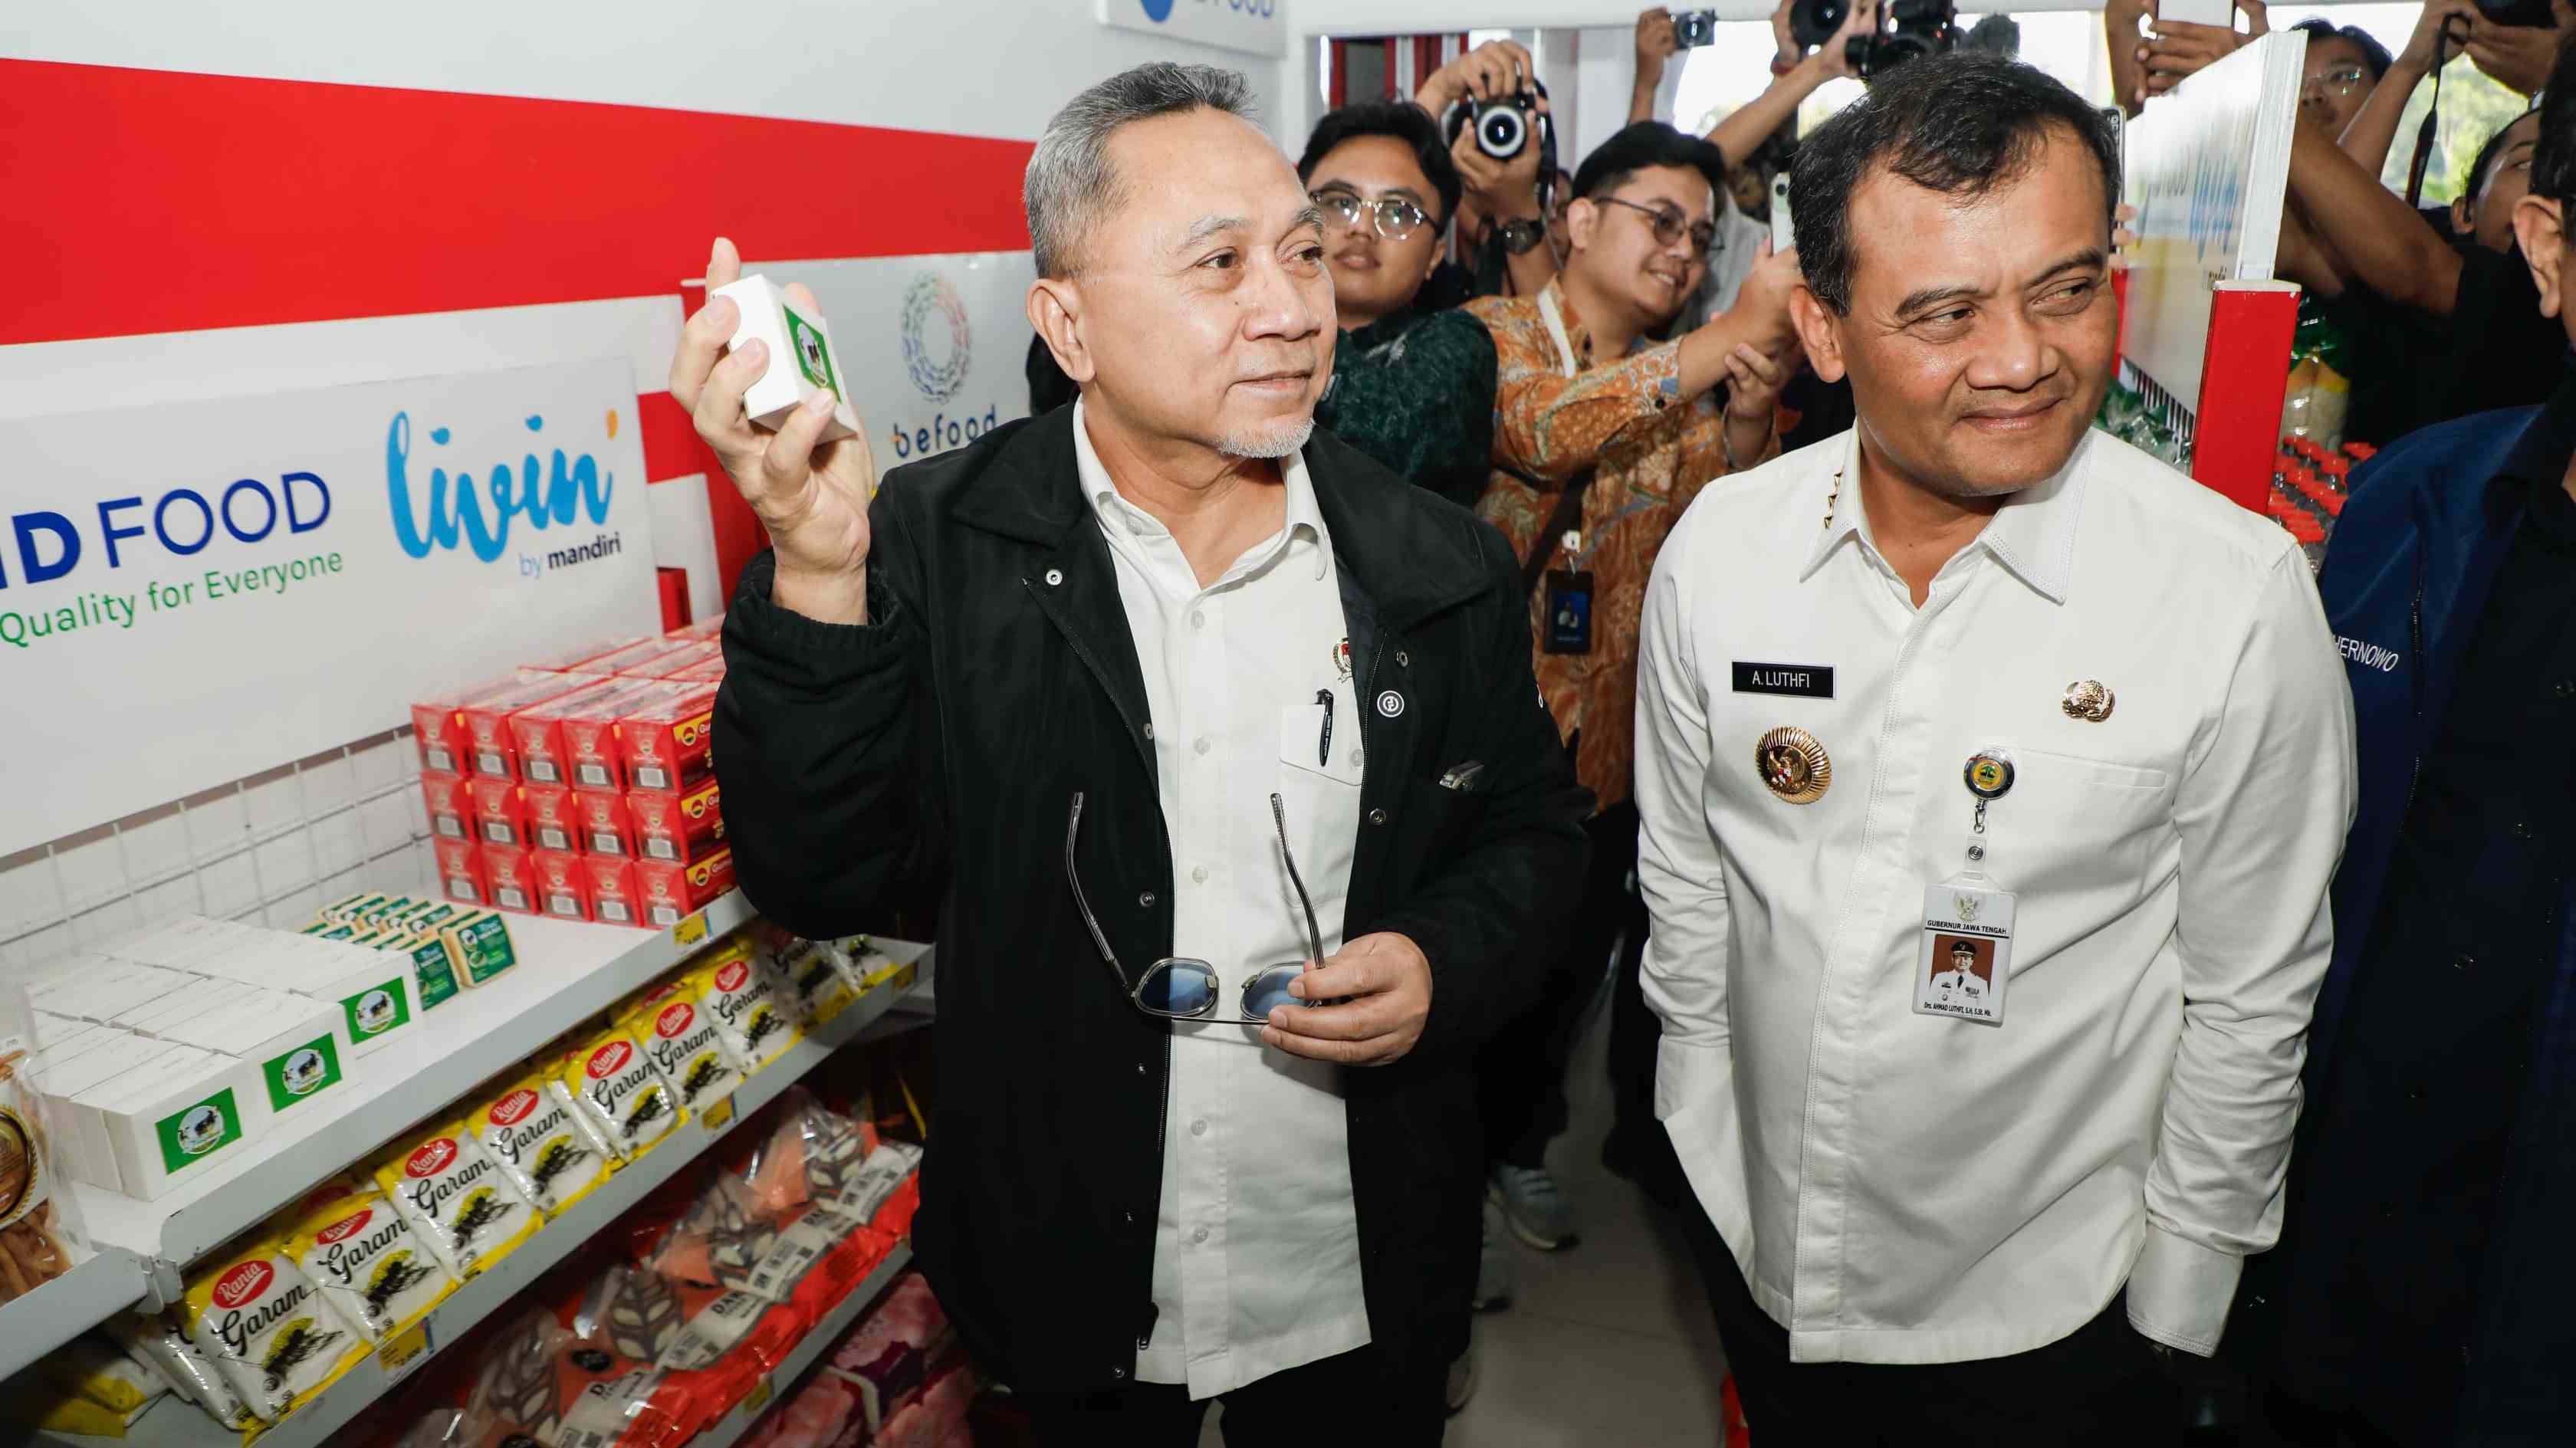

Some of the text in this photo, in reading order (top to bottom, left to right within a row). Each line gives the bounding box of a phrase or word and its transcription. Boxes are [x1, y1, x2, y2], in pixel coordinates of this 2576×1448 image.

[891, 403, 996, 458] befood
[97, 471, 330, 569] FOOD
[519, 531, 622, 579] by mandiri
[0, 550, 343, 648] Quality for Everyone
[1752, 670, 1809, 688] A. LUTHFI
[1927, 919, 2007, 935] GUBERNUR JAWA TENGAH
[590, 1042, 627, 1073] Rania
[652, 1026, 719, 1075] Garam
[494, 1090, 533, 1124] Rania
[591, 1062, 659, 1115] Garam
[410, 1139, 452, 1174] Rania
[490, 1107, 570, 1164] Garam
[407, 1158, 491, 1219] Garam
[317, 1218, 409, 1285] Garam
[218, 1262, 264, 1302] Rania
[211, 1285, 308, 1357] Garam
